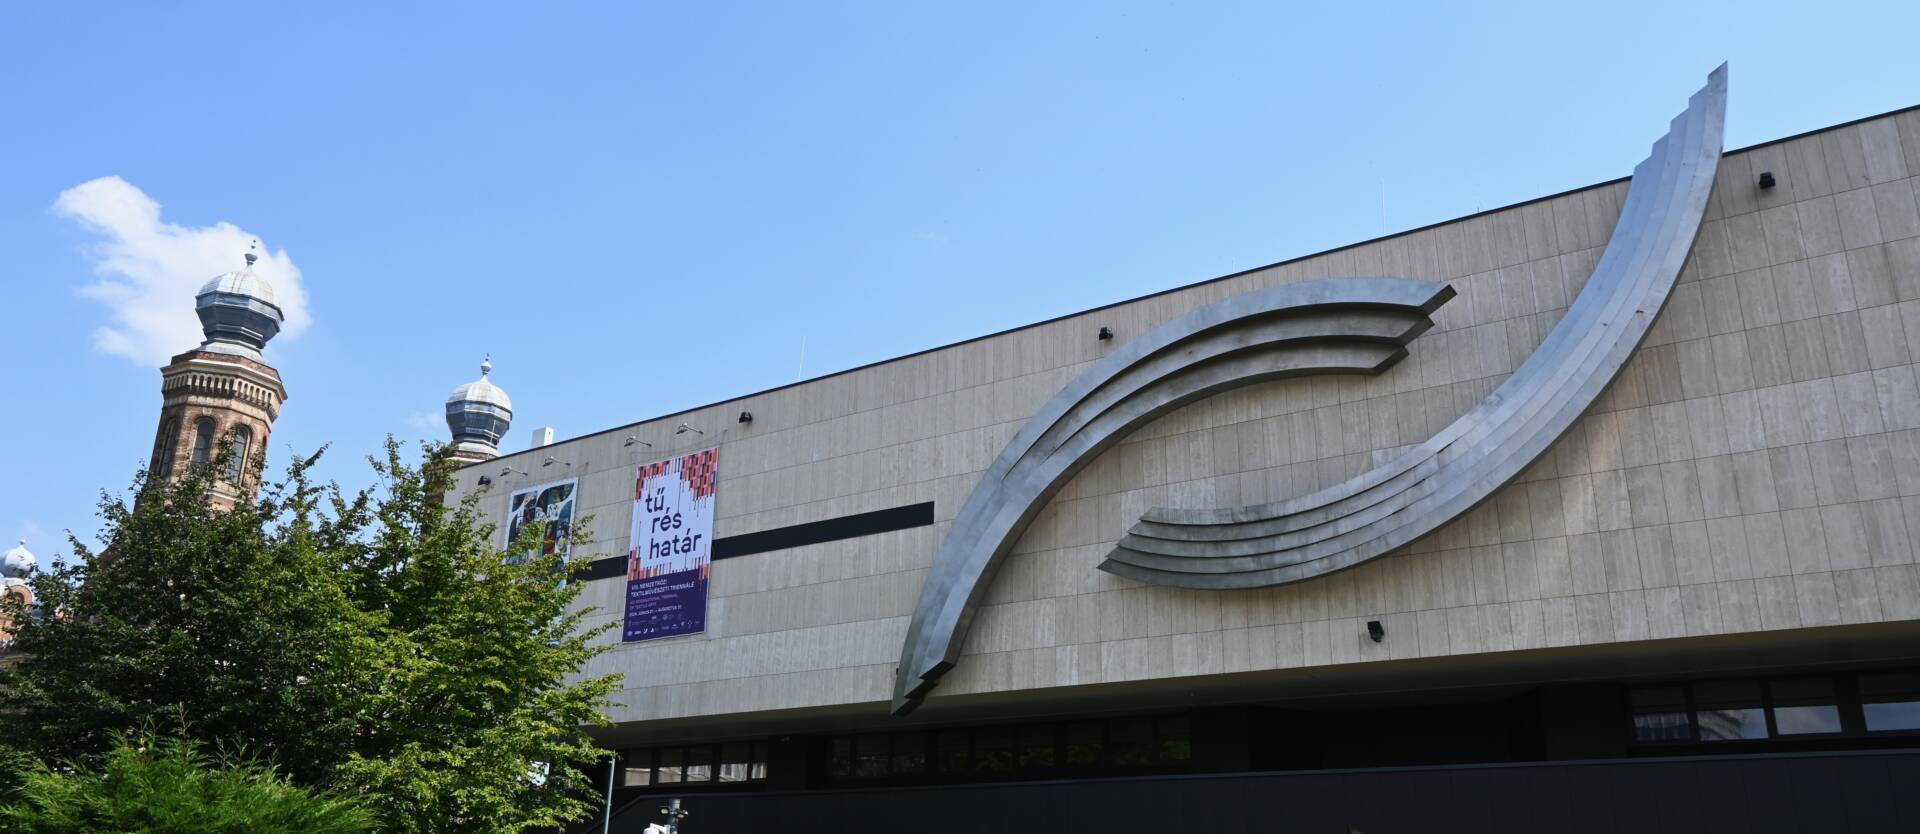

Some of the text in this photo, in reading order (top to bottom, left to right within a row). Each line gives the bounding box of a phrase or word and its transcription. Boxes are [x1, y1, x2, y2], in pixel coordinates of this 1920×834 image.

[645, 487, 665, 513] tű
[651, 506, 682, 534] rés
[649, 527, 702, 560] határ
